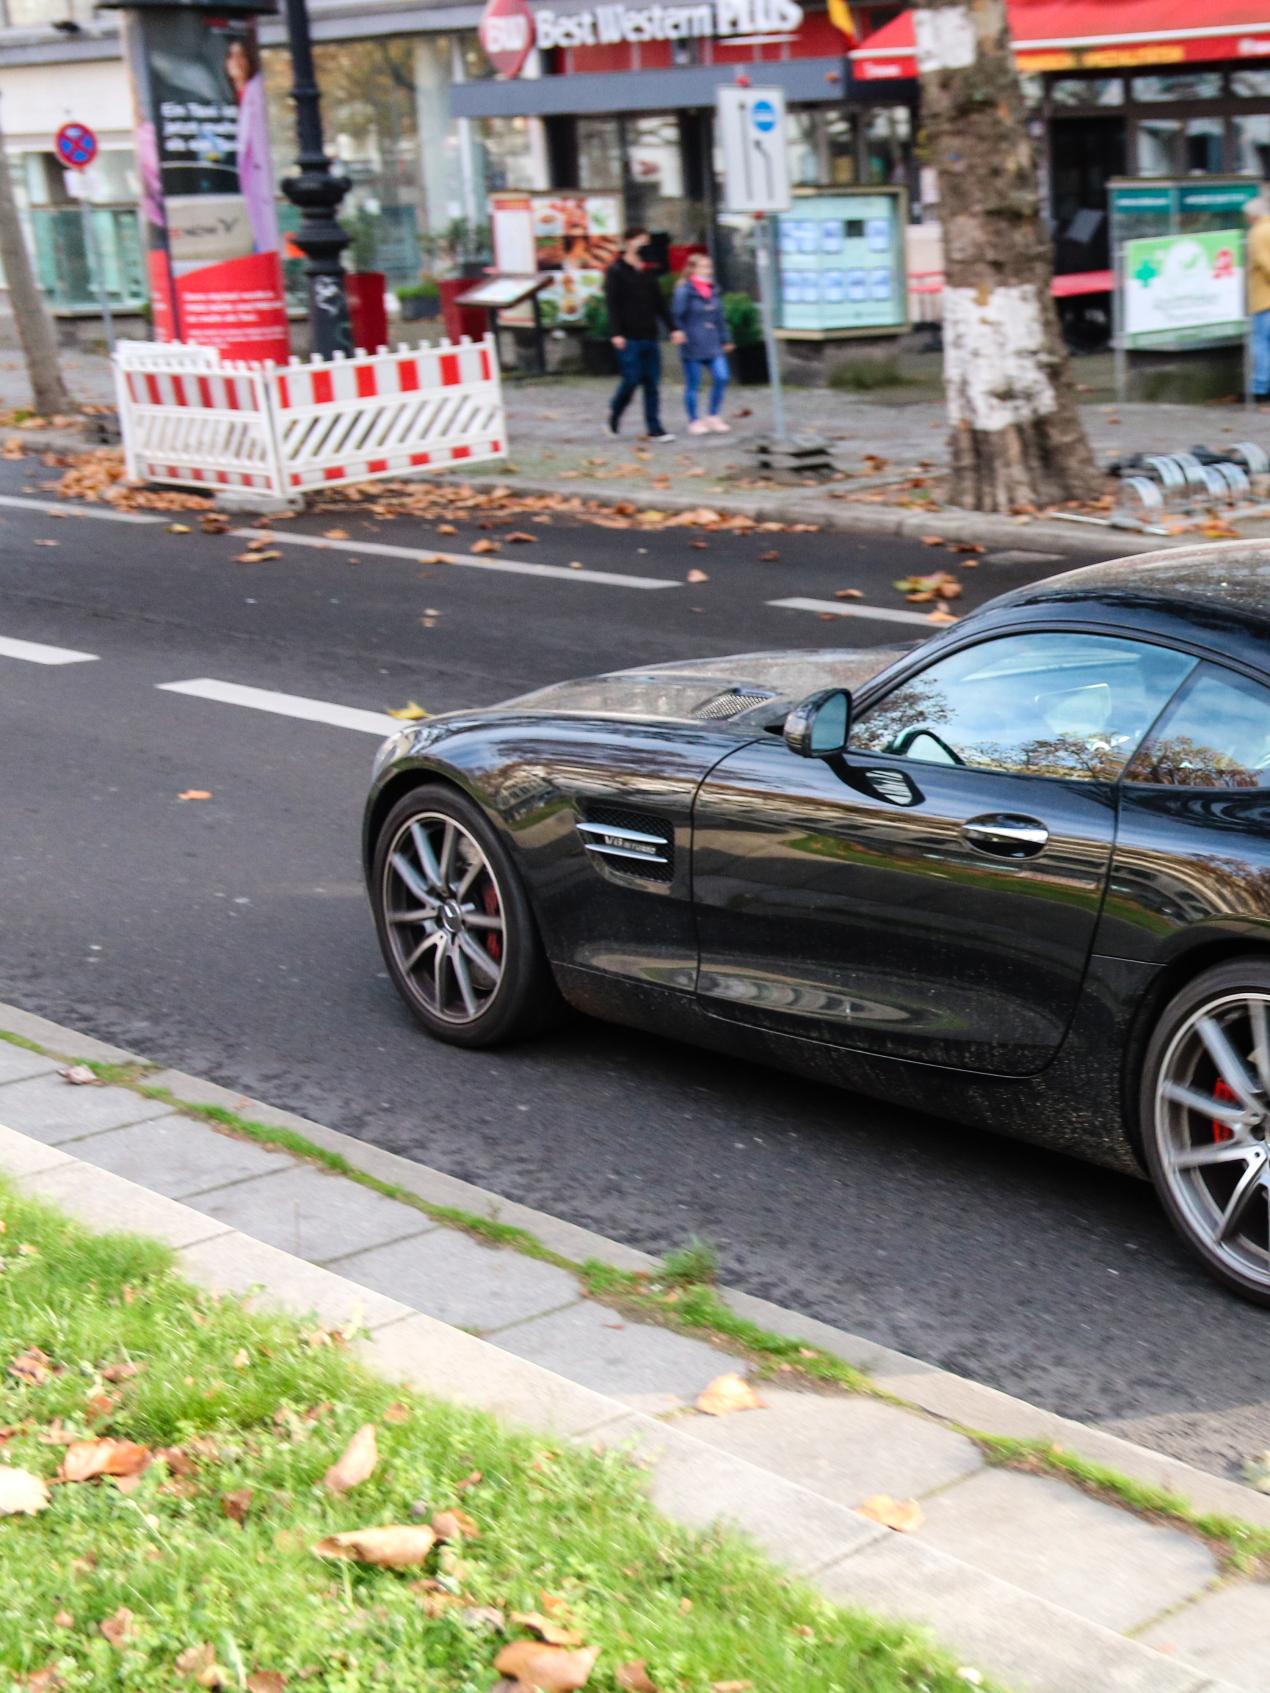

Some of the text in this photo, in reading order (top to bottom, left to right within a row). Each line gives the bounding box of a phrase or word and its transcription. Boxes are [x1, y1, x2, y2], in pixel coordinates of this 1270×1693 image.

[537, 0, 804, 49] Best Western PLUS
